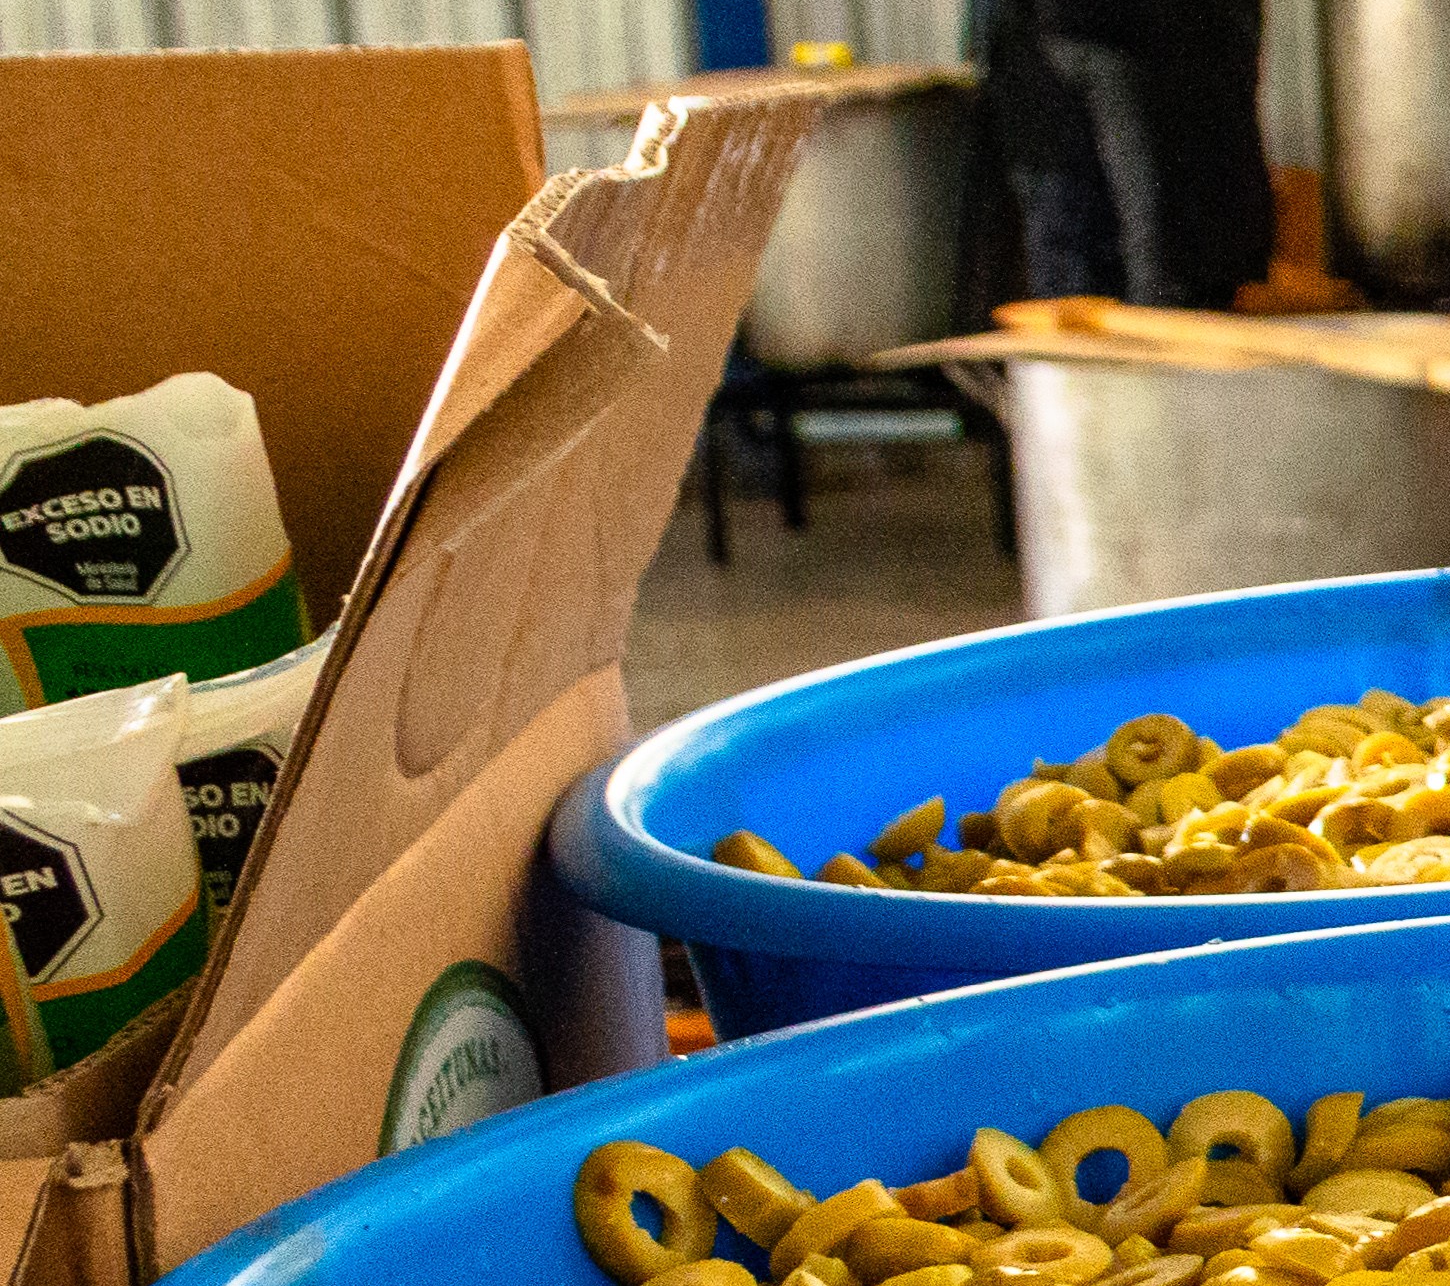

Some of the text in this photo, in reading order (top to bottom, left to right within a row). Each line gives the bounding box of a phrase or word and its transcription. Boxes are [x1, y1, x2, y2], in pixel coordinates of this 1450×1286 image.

[2, 485, 162, 531] EXCESO EN
[46, 514, 141, 543] SODIO
[191, 813, 241, 839] DIO
[1, 867, 58, 898] EN
